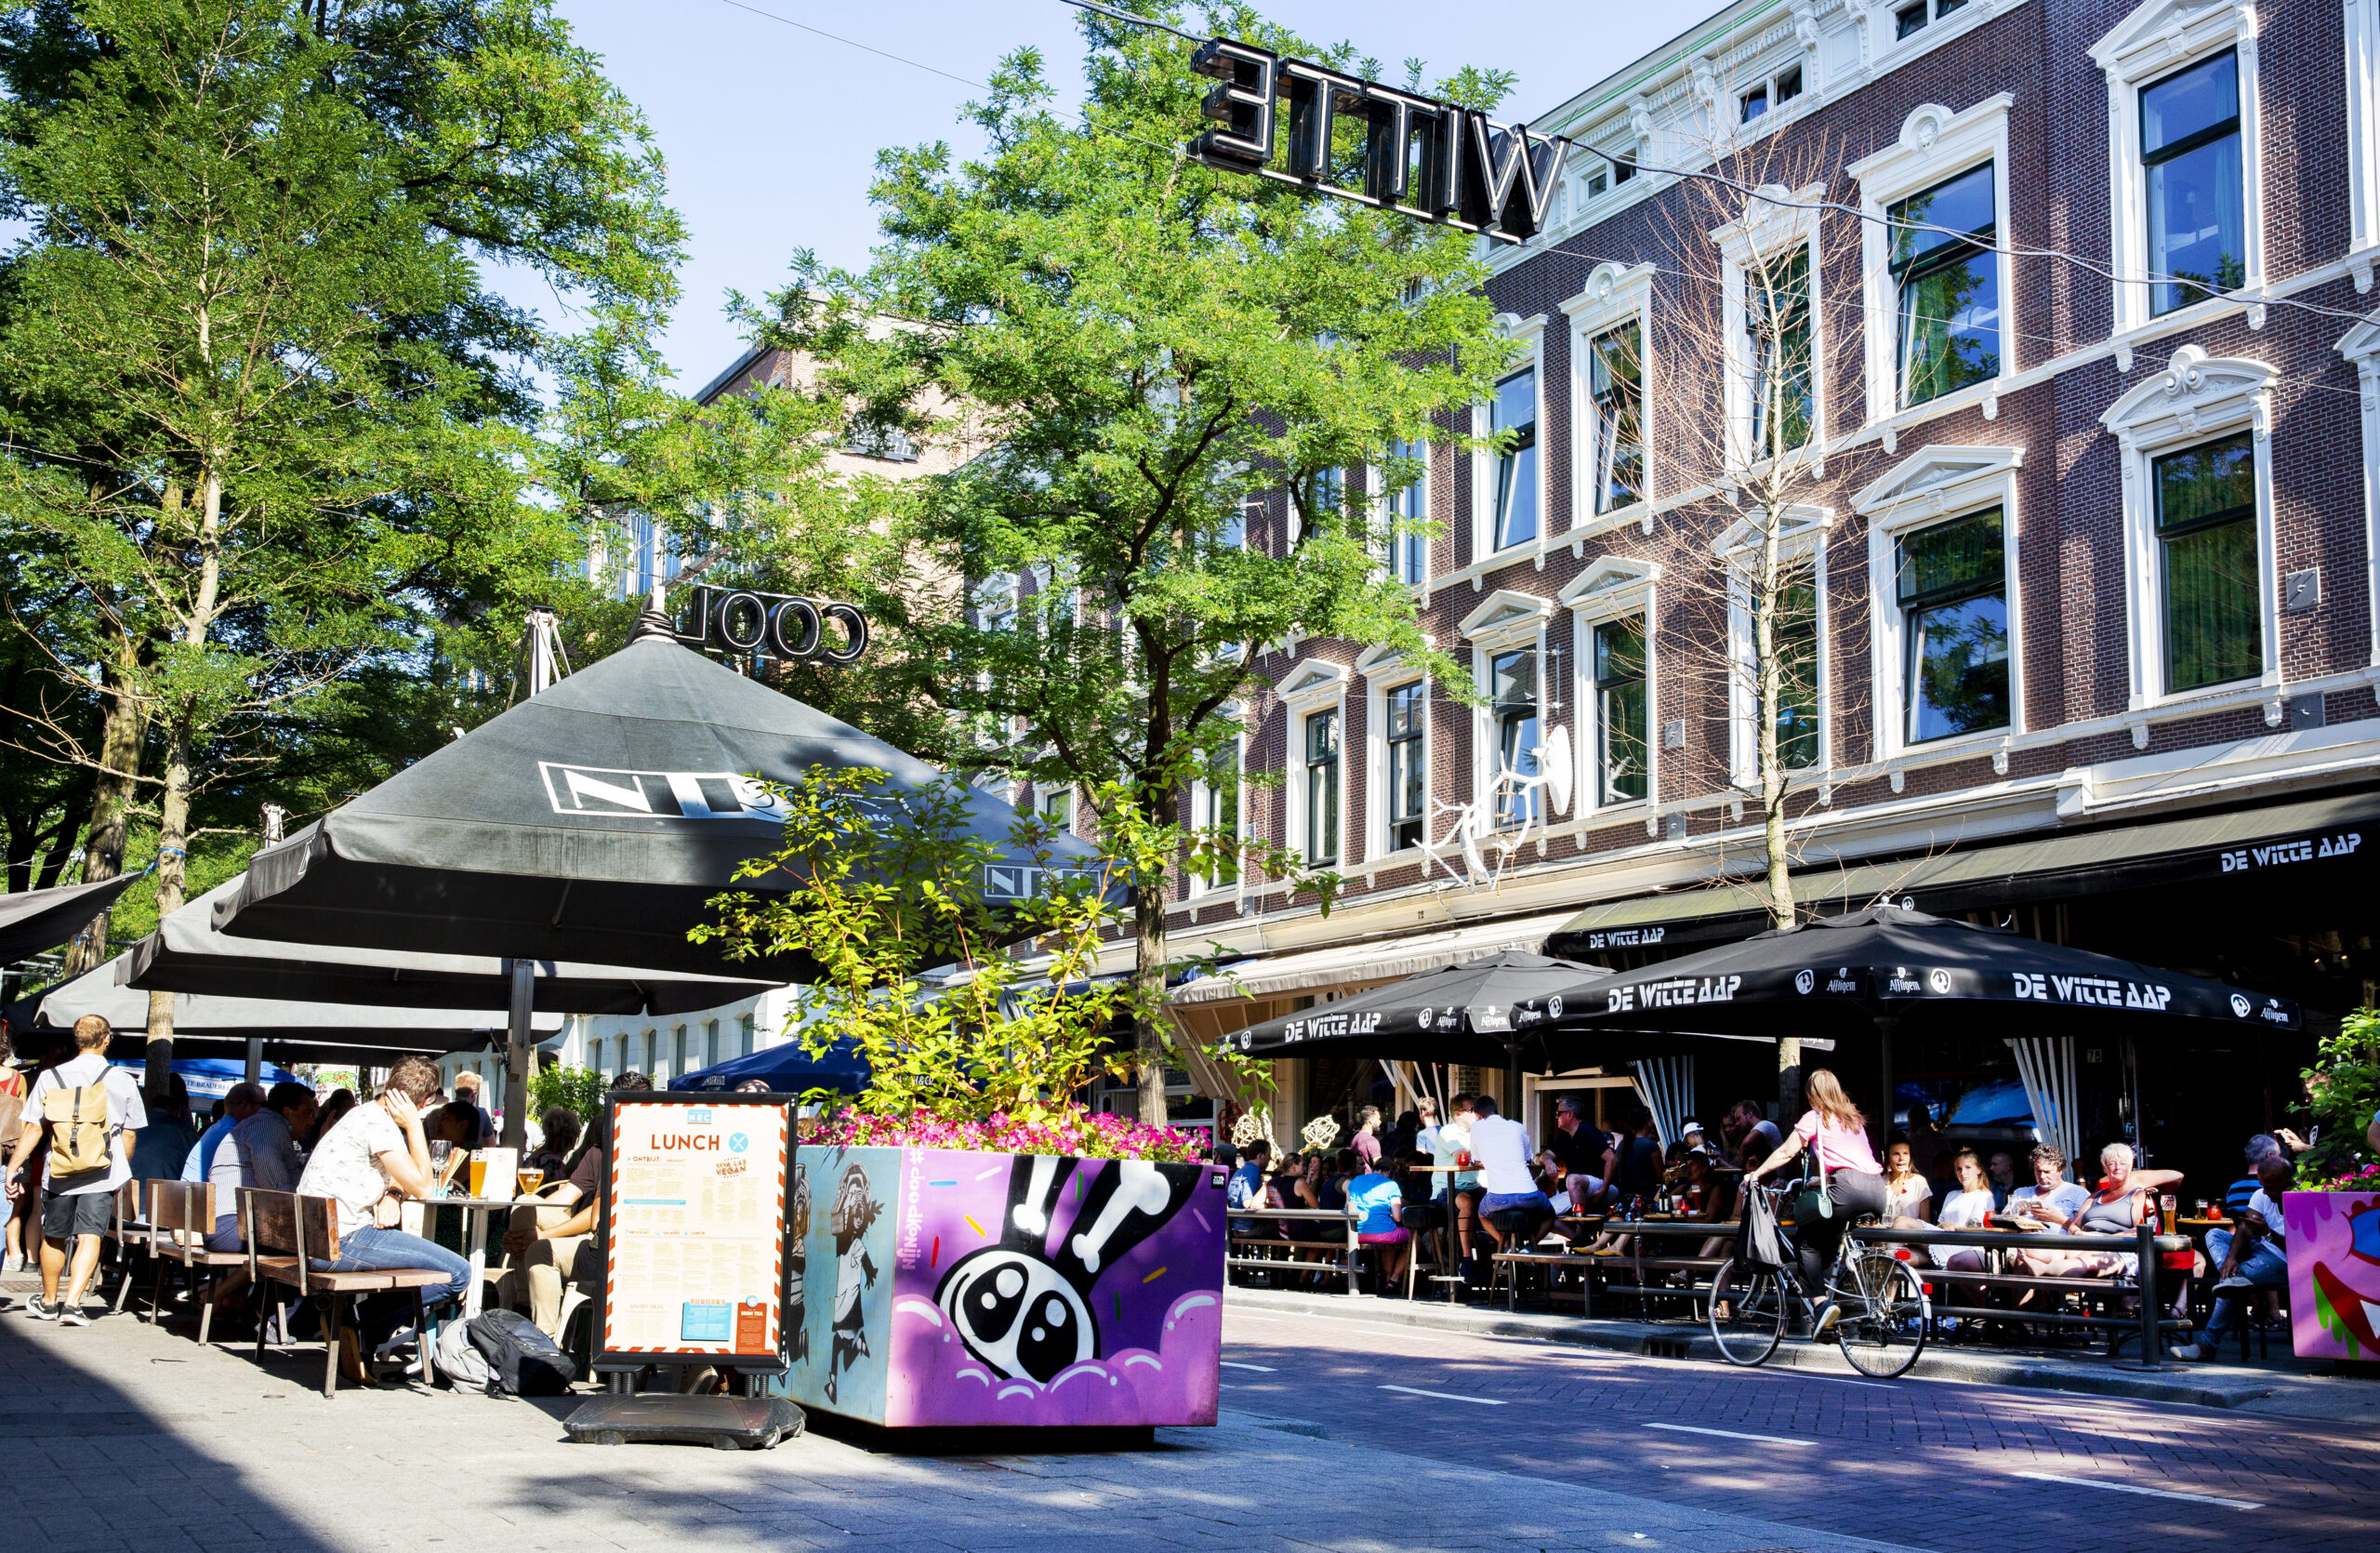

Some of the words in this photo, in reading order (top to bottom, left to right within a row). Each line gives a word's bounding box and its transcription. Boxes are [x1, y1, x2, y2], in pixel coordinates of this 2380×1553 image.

[2221, 850, 2249, 872] DE
[2252, 840, 2313, 867] WITTE
[2318, 832, 2361, 858] AAP
[1590, 934, 1605, 949] DE
[1606, 930, 1639, 947] WITTE
[1641, 927, 1665, 944] AAP
[1826, 979, 1856, 994] Affligem
[1889, 978, 1921, 993] Affligem
[2012, 973, 2048, 1000] DE
[2051, 975, 2122, 1006] WITTE
[2125, 982, 2172, 1011] AAP
[1608, 986, 1634, 1013] DE
[1638, 978, 1697, 1008] WITTE
[1697, 975, 1741, 1003] AAP
[1481, 1015, 1508, 1029] Affligem
[1518, 1010, 1541, 1024] Affligem
[2260, 1007, 2289, 1023] Affligem
[1285, 1020, 1304, 1043] DE
[1307, 1014, 1348, 1039] WITTE
[1350, 1012, 1382, 1034] AAP
[652, 1134, 720, 1151] LUNCH
[716, 1166, 747, 1175] VEGAN
